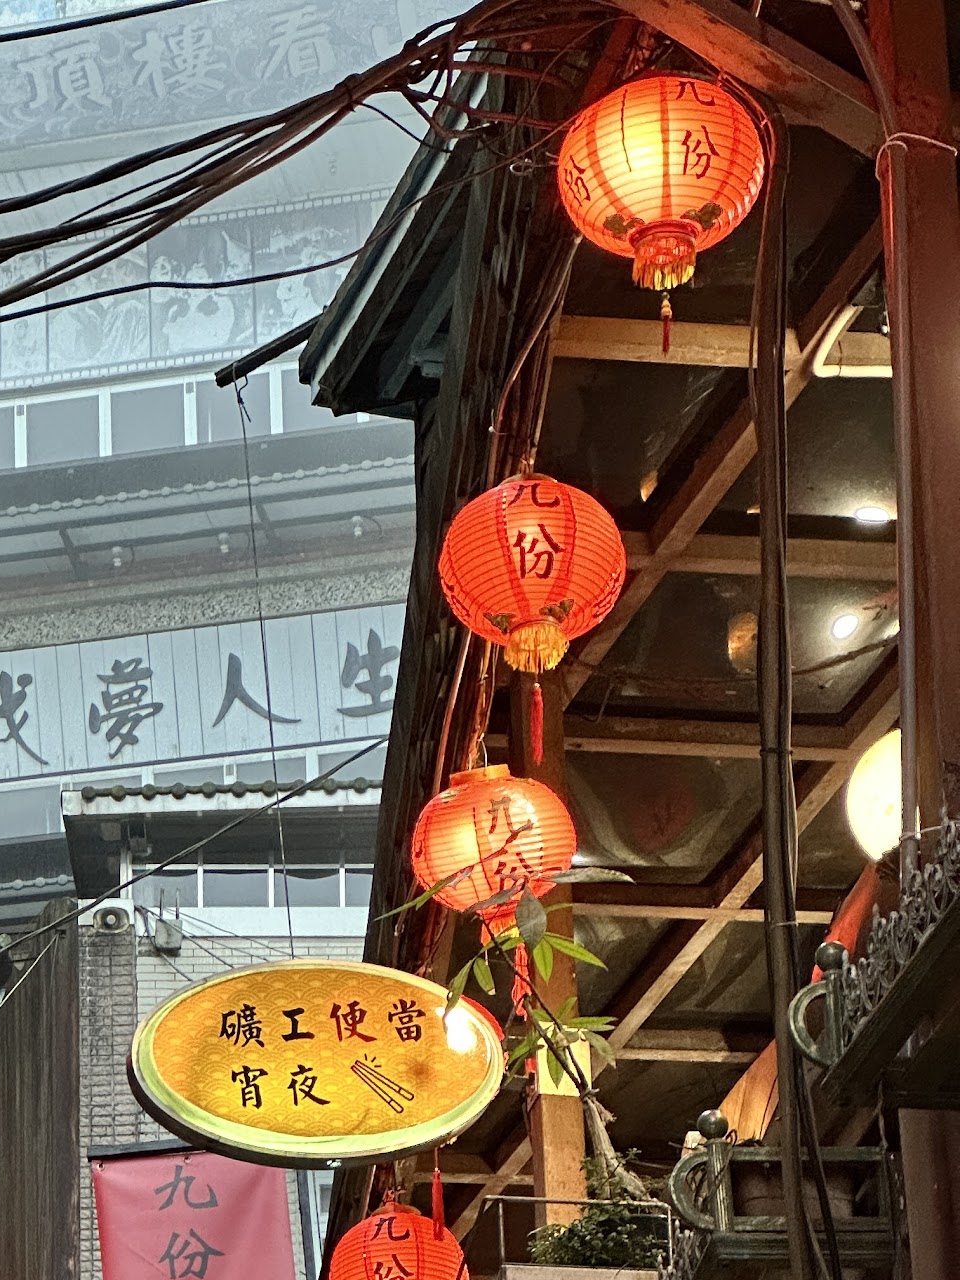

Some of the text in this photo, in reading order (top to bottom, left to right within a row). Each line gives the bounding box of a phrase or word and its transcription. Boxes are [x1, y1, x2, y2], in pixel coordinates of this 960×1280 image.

[675, 80, 721, 180] 九份
[508, 481, 564, 580] 九份
[218, 998, 428, 1052] 礦工便當
[230, 1063, 332, 1109] 宵夜
